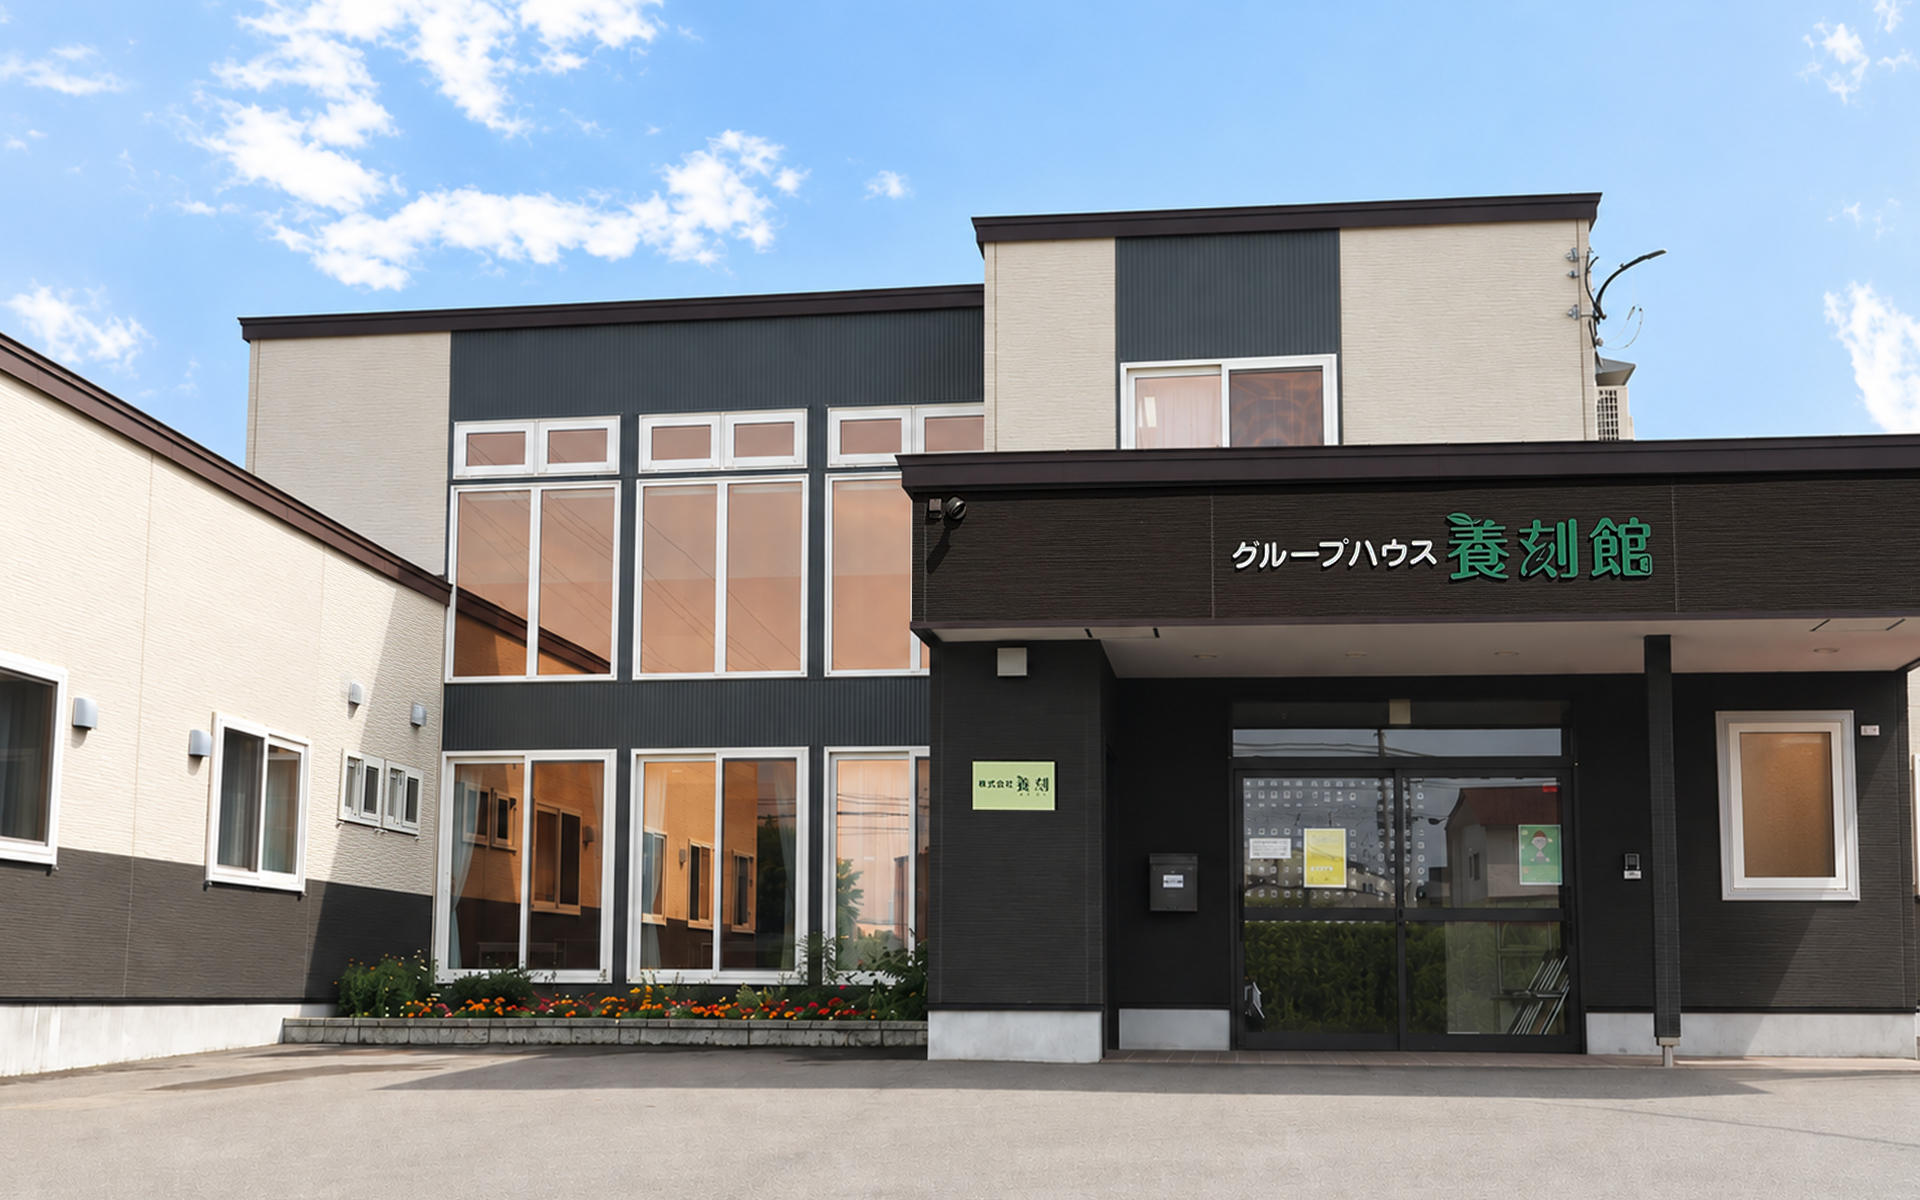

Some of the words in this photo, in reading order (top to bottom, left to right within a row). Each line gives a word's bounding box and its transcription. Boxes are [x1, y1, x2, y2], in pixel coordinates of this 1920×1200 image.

[1232, 538, 1437, 569] グループハウス
